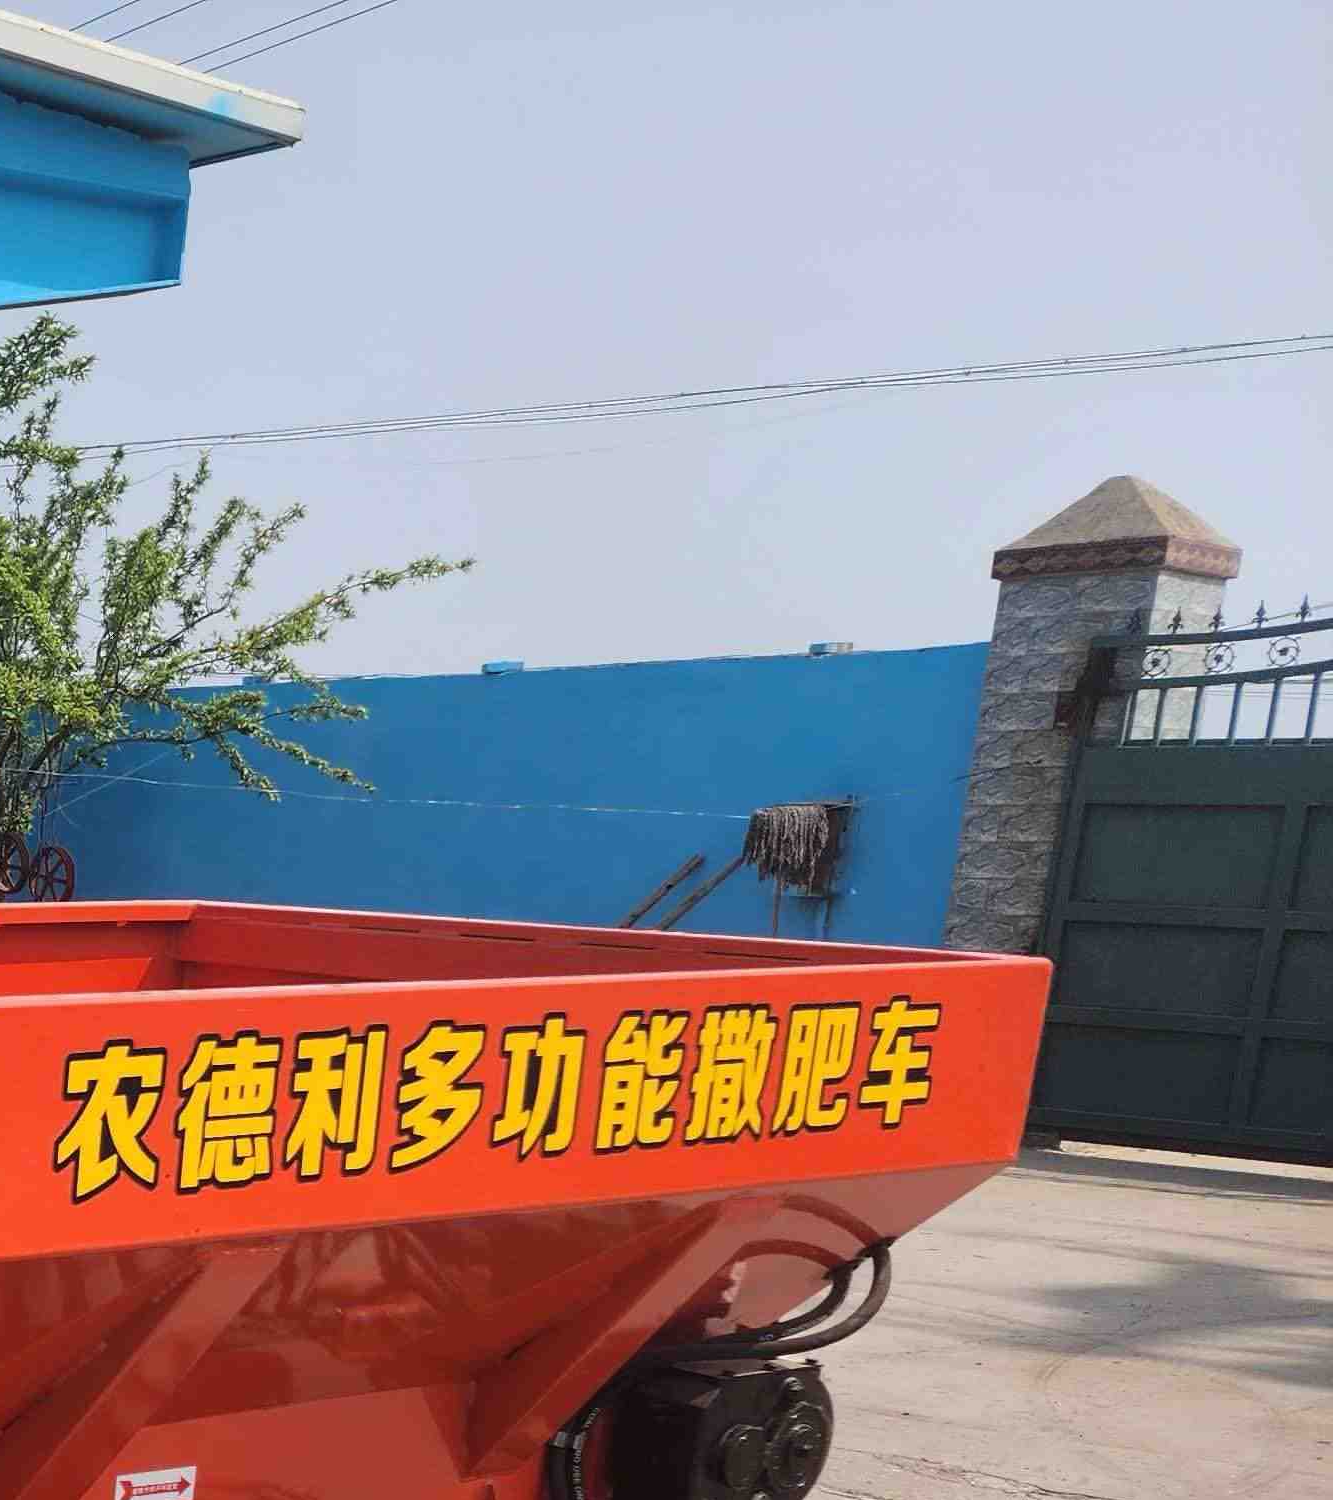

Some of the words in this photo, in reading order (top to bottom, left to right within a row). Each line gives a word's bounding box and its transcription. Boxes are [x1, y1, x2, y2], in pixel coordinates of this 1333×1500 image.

[53, 996, 940, 1202] 农德利多功能撒肥车
